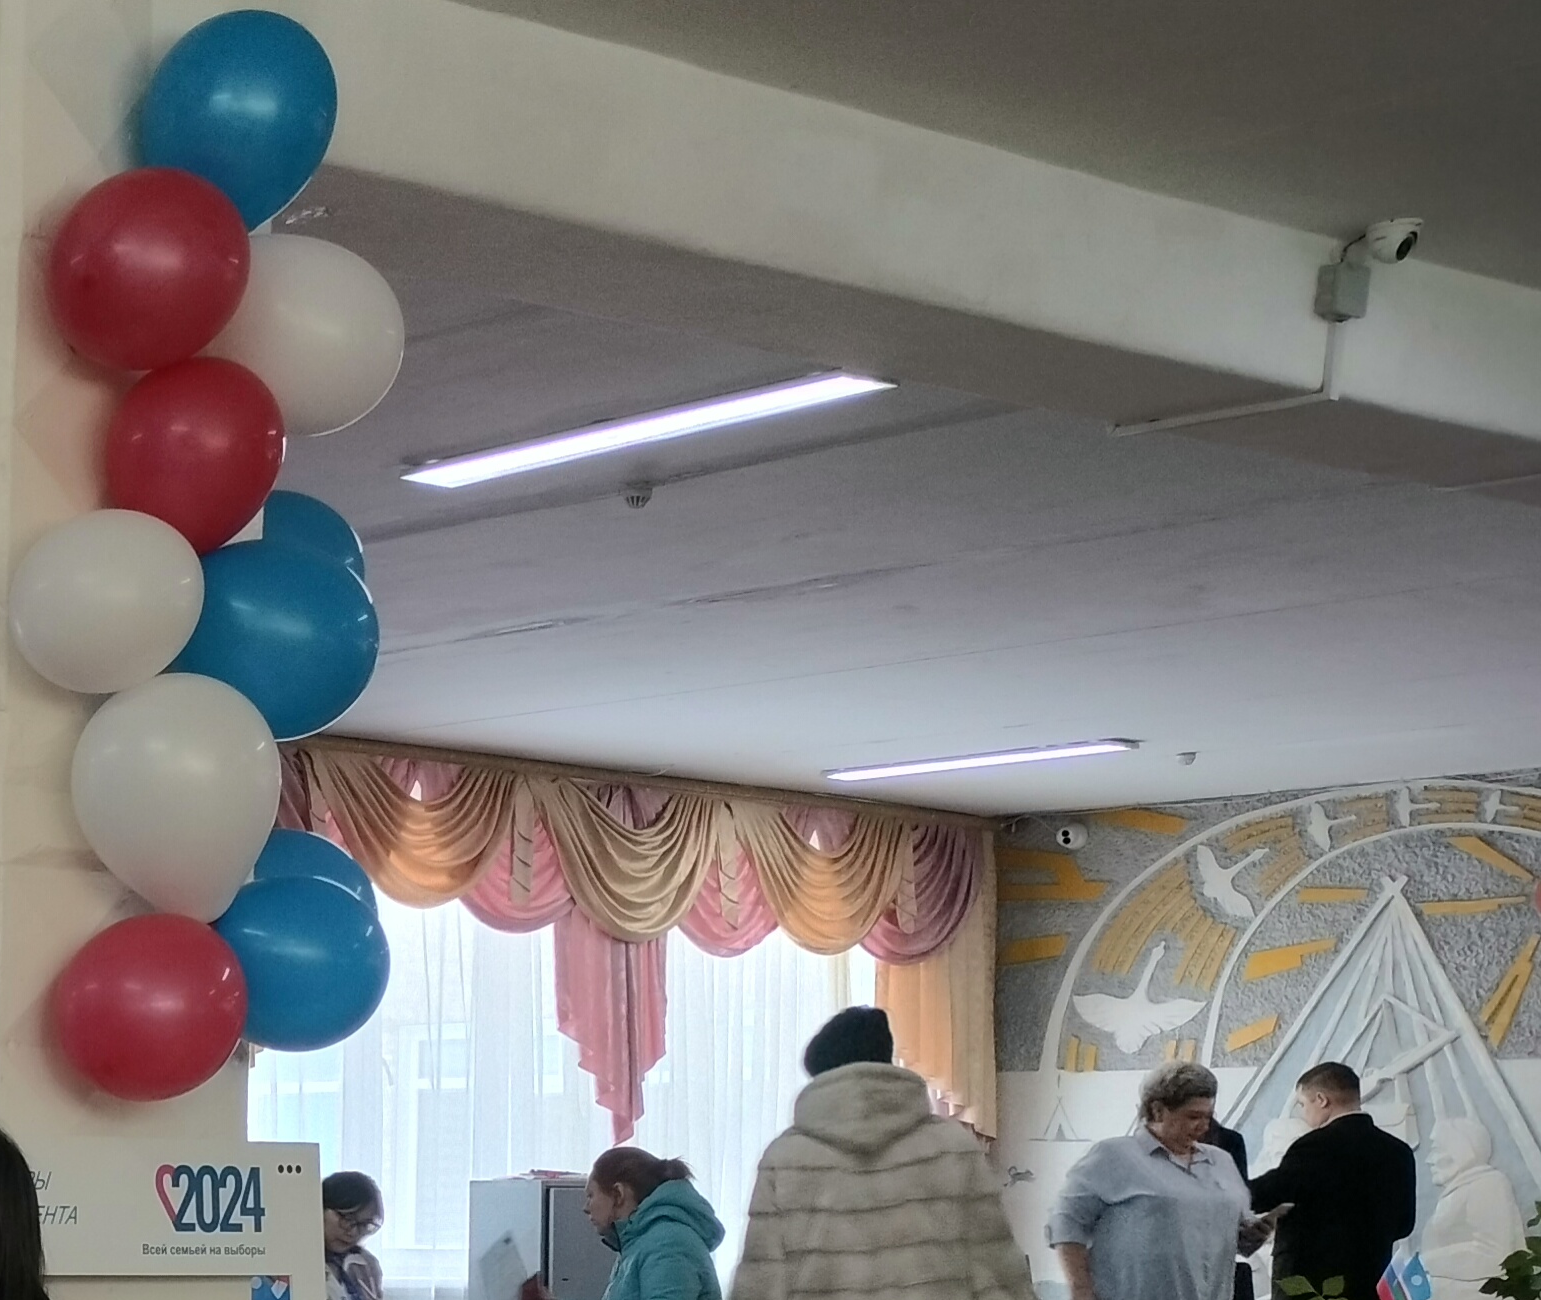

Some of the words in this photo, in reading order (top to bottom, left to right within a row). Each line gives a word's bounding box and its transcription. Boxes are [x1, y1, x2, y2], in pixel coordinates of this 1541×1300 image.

[172, 1164, 266, 1233] 2024
[142, 1243, 168, 1255] Всей
[169, 1244, 207, 1255] семьей
[210, 1246, 222, 1255] на
[224, 1244, 266, 1258] выборы
